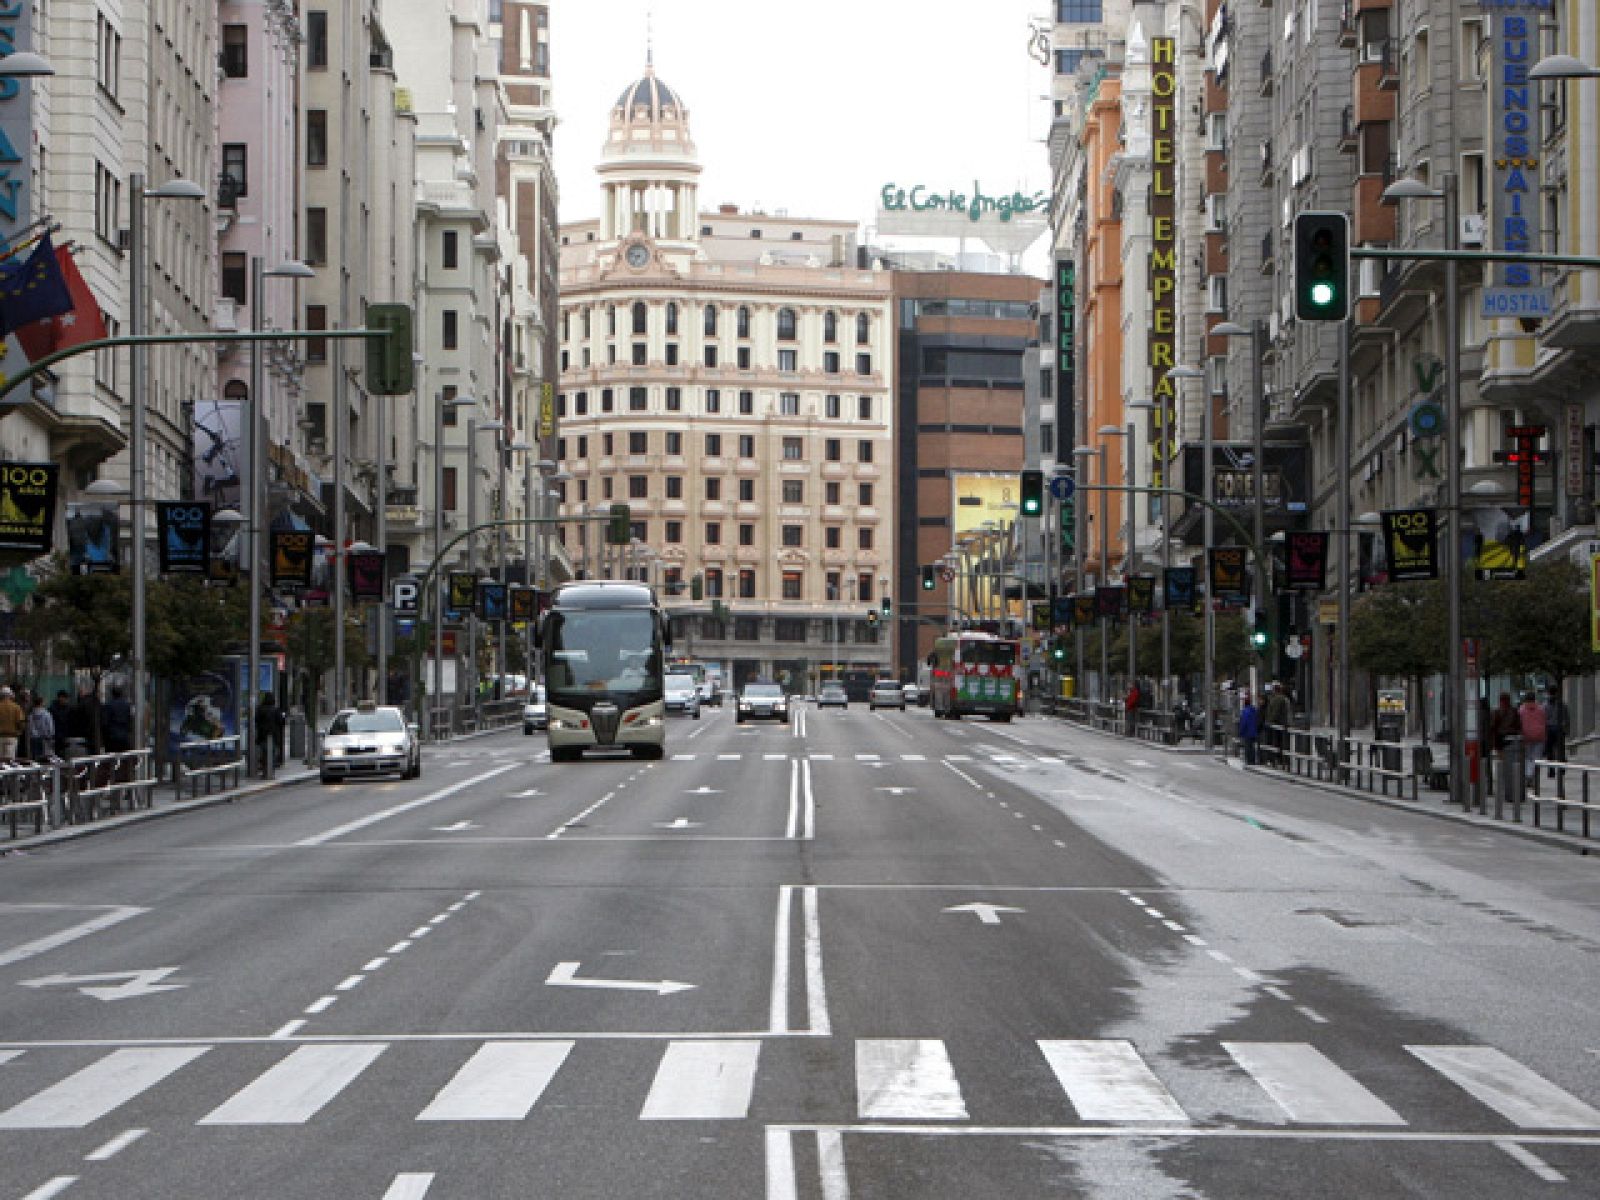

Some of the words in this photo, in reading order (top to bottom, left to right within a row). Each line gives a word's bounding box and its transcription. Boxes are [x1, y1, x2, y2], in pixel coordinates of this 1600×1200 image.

[1153, 38, 1175, 196] HOTEL
[1504, 16, 1528, 156] BUENOS
[881, 183, 907, 210] El
[910, 184, 965, 211] Corte
[1504, 168, 1530, 285] AIRES
[1061, 269, 1073, 371] HOTEL
[1484, 294, 1549, 312] HOSTAL
[2, 466, 48, 486] 100
[1391, 512, 1428, 529] 100
